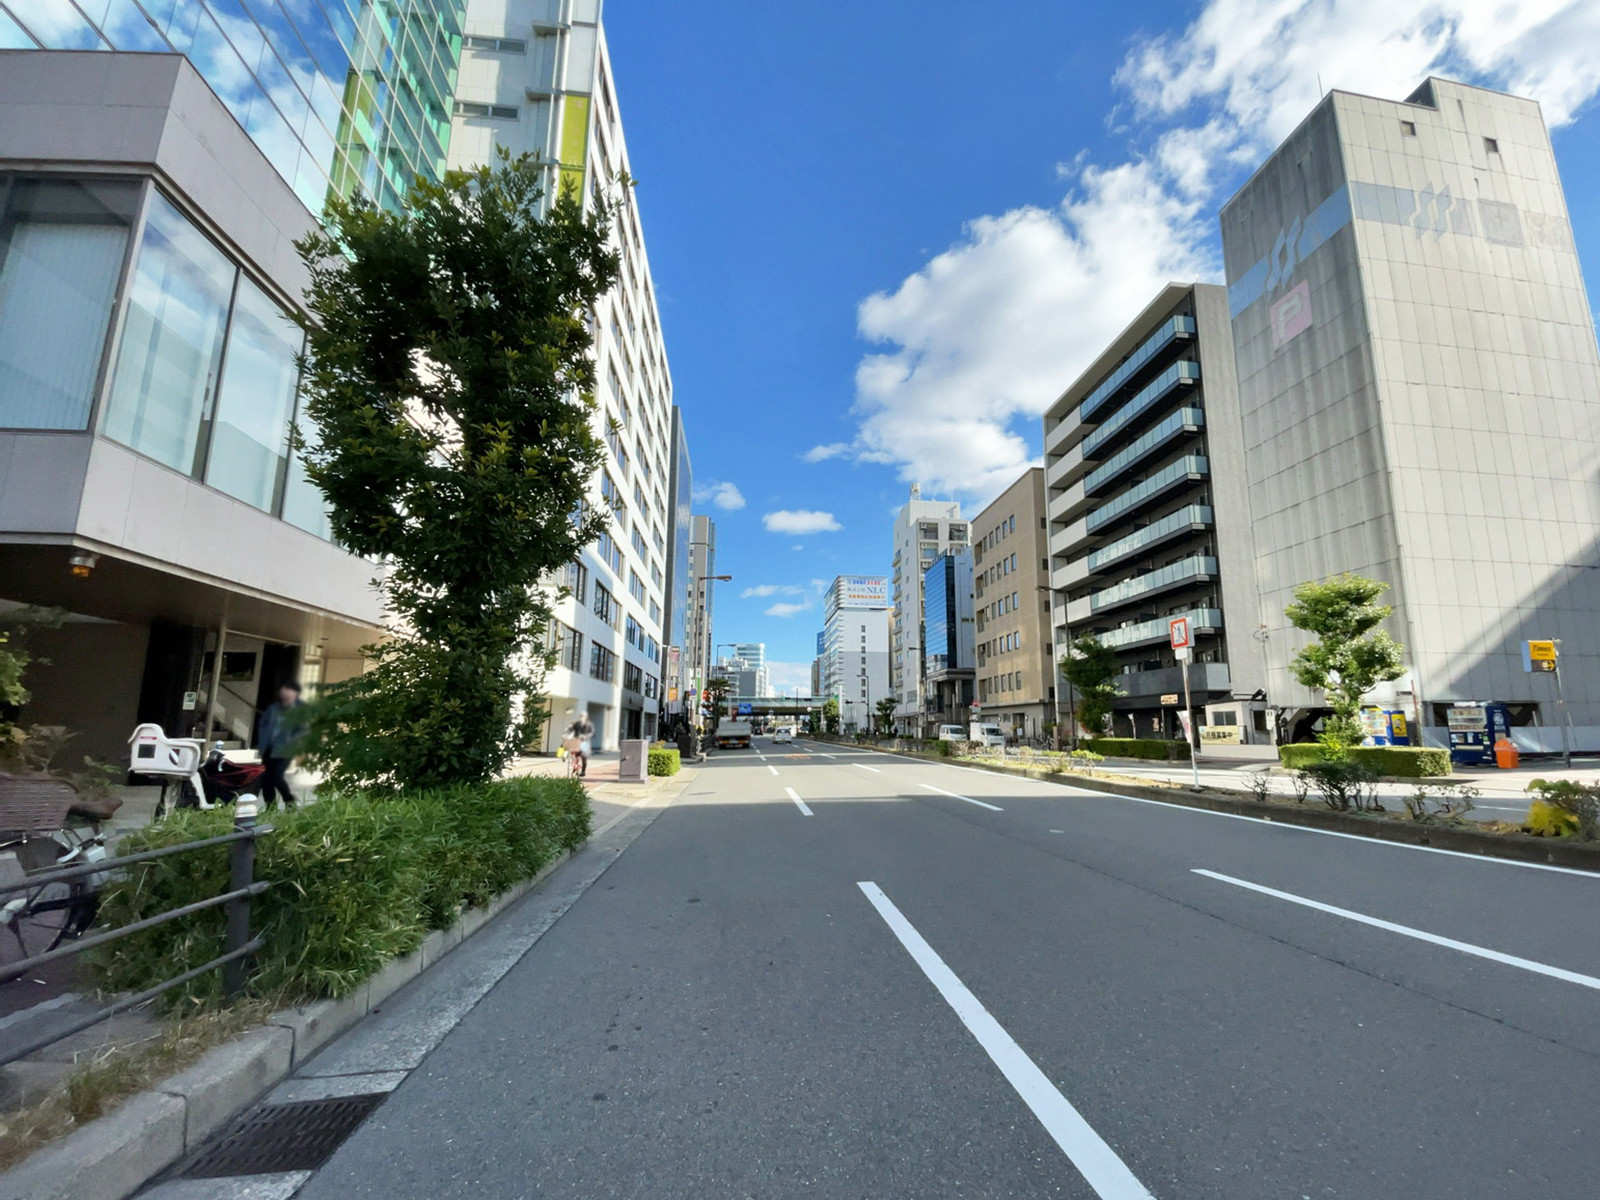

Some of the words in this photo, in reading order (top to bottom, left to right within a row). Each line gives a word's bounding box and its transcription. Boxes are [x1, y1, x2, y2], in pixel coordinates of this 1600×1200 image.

[1277, 293, 1304, 341] P
[867, 586, 886, 594] NLC
[1532, 644, 1552, 652] Times
